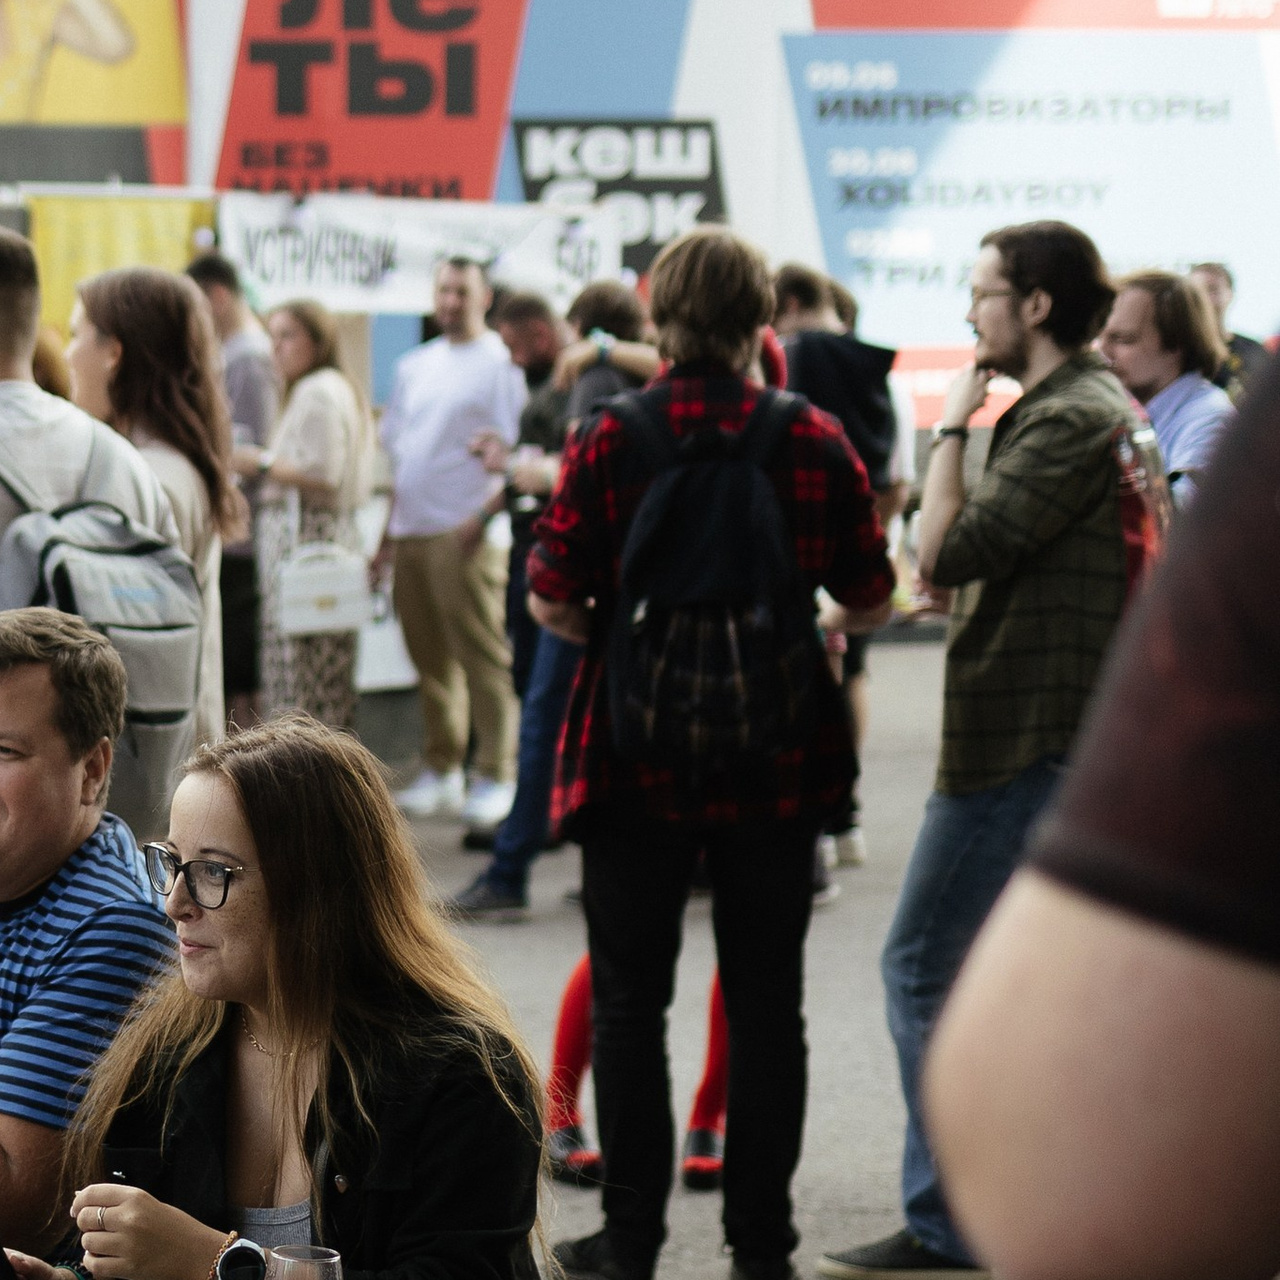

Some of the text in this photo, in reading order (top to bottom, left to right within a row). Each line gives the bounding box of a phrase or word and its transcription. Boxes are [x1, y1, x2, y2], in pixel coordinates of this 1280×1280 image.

[247, 40, 477, 118] ты
[815, 93, 1230, 122] ИМПРОВИЗАТОРЫ
[241, 141, 329, 168] БЕЗ
